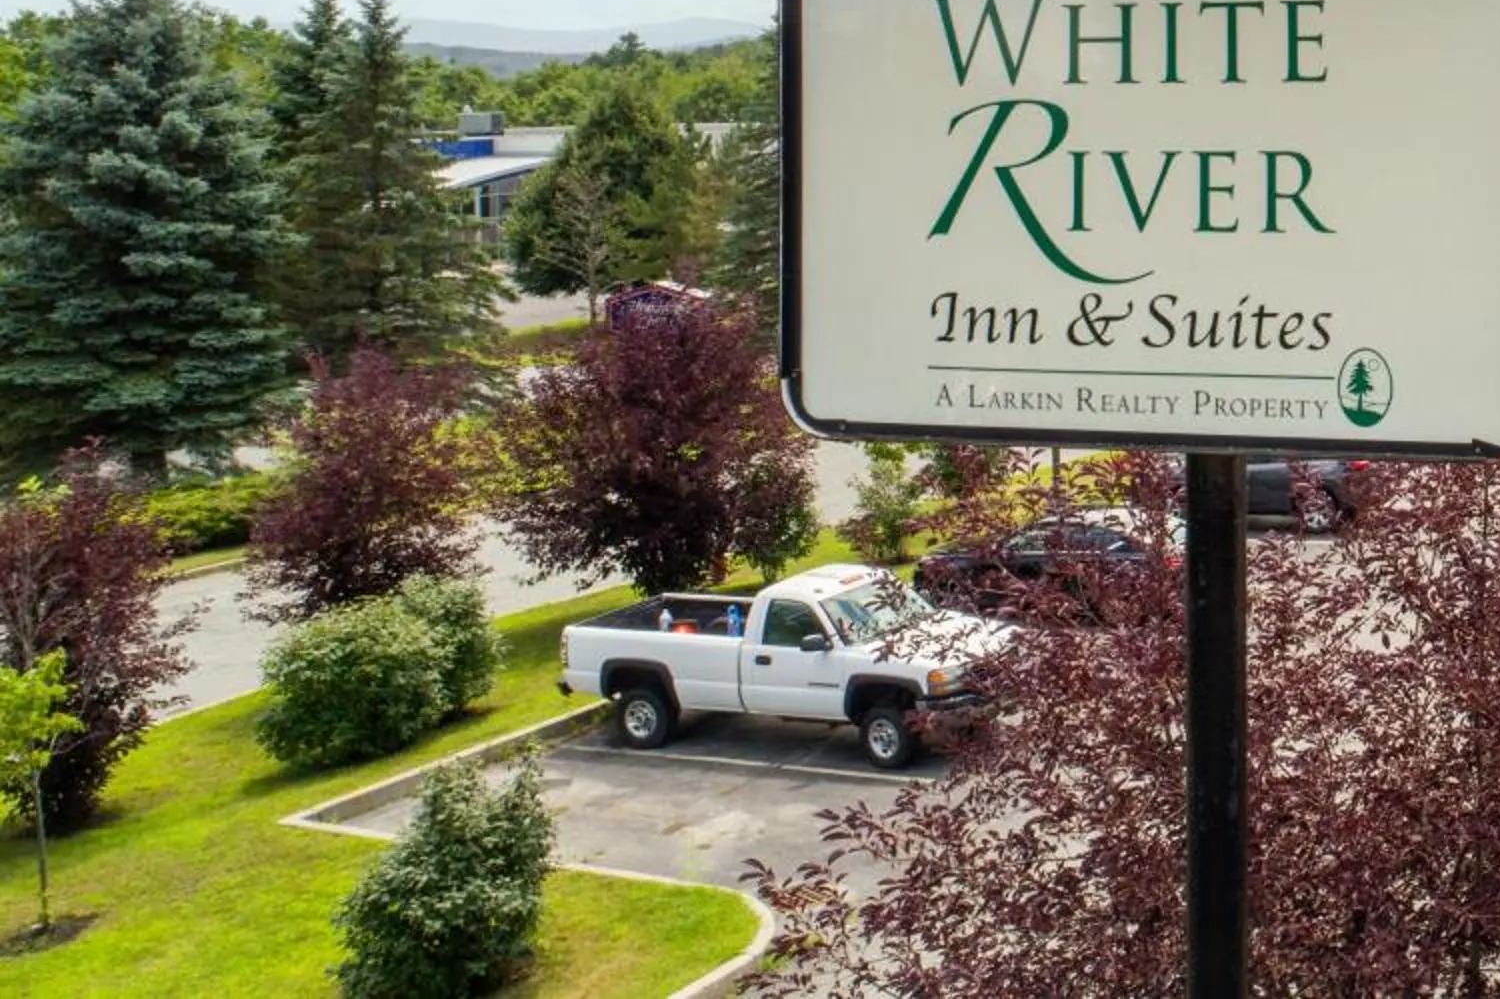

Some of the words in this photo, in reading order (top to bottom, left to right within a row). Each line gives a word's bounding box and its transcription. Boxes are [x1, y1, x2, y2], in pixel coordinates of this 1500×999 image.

[926, 98, 1338, 286] RIVER
[930, 291, 1045, 346] Inn
[1065, 291, 1135, 348] &
[1140, 293, 1334, 352] Suites
[935, 383, 954, 409] A
[967, 383, 1064, 412] LARKIN
[1075, 385, 1181, 415] REALTY
[1192, 388, 1330, 420] PROPERTY
